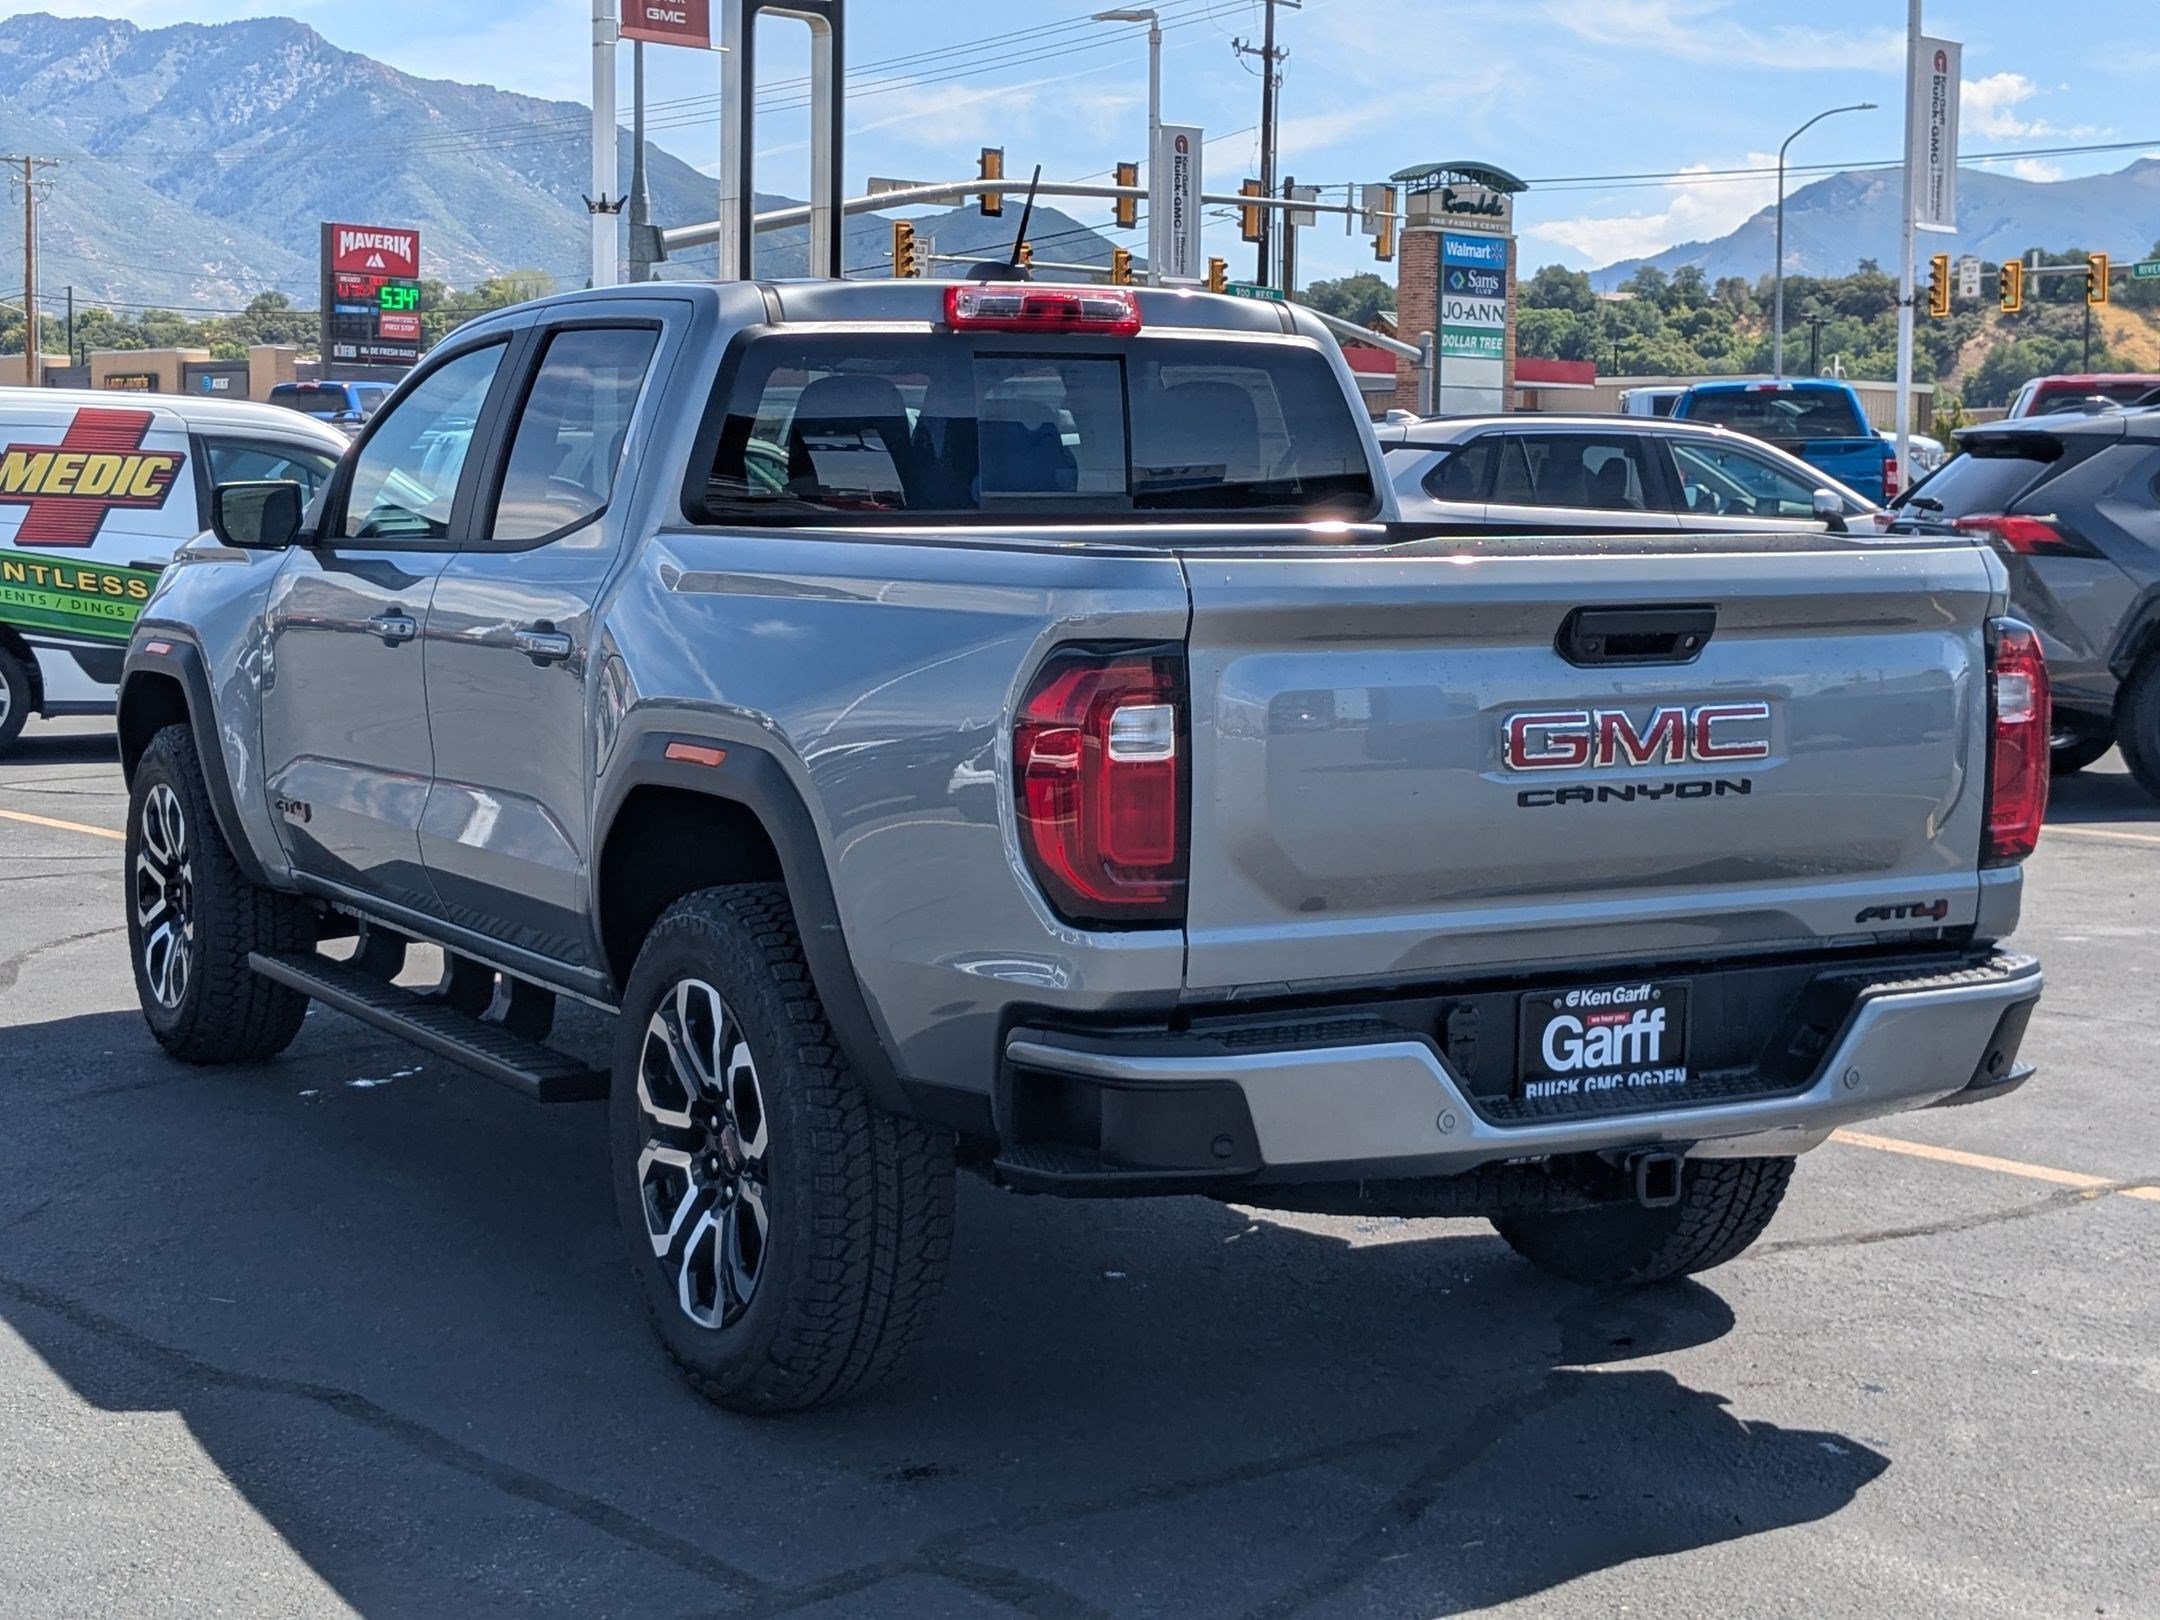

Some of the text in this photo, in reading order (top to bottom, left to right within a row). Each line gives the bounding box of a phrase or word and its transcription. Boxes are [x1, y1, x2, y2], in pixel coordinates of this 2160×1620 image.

[646, 7, 687, 24] GMC
[1430, 216, 1446, 225] THE
[1447, 218, 1479, 228] FAMILY
[339, 230, 412, 264] MAVERIK
[1446, 241, 1491, 260] Walmart
[1467, 269, 1499, 289] Sam's
[1235, 287, 1275, 300] 900 WEST
[1442, 334, 1503, 350] DOLLAR TREE
[0, 452, 173, 497] MEDIC
[71, 599, 126, 617] DINGS
[1503, 701, 1770, 772] GMC
[1517, 778, 1752, 808] CANYON
[1855, 898, 1949, 924] AT4
[1580, 984, 1652, 1007] Ken Garff
[1542, 1007, 1666, 1073] Garff
